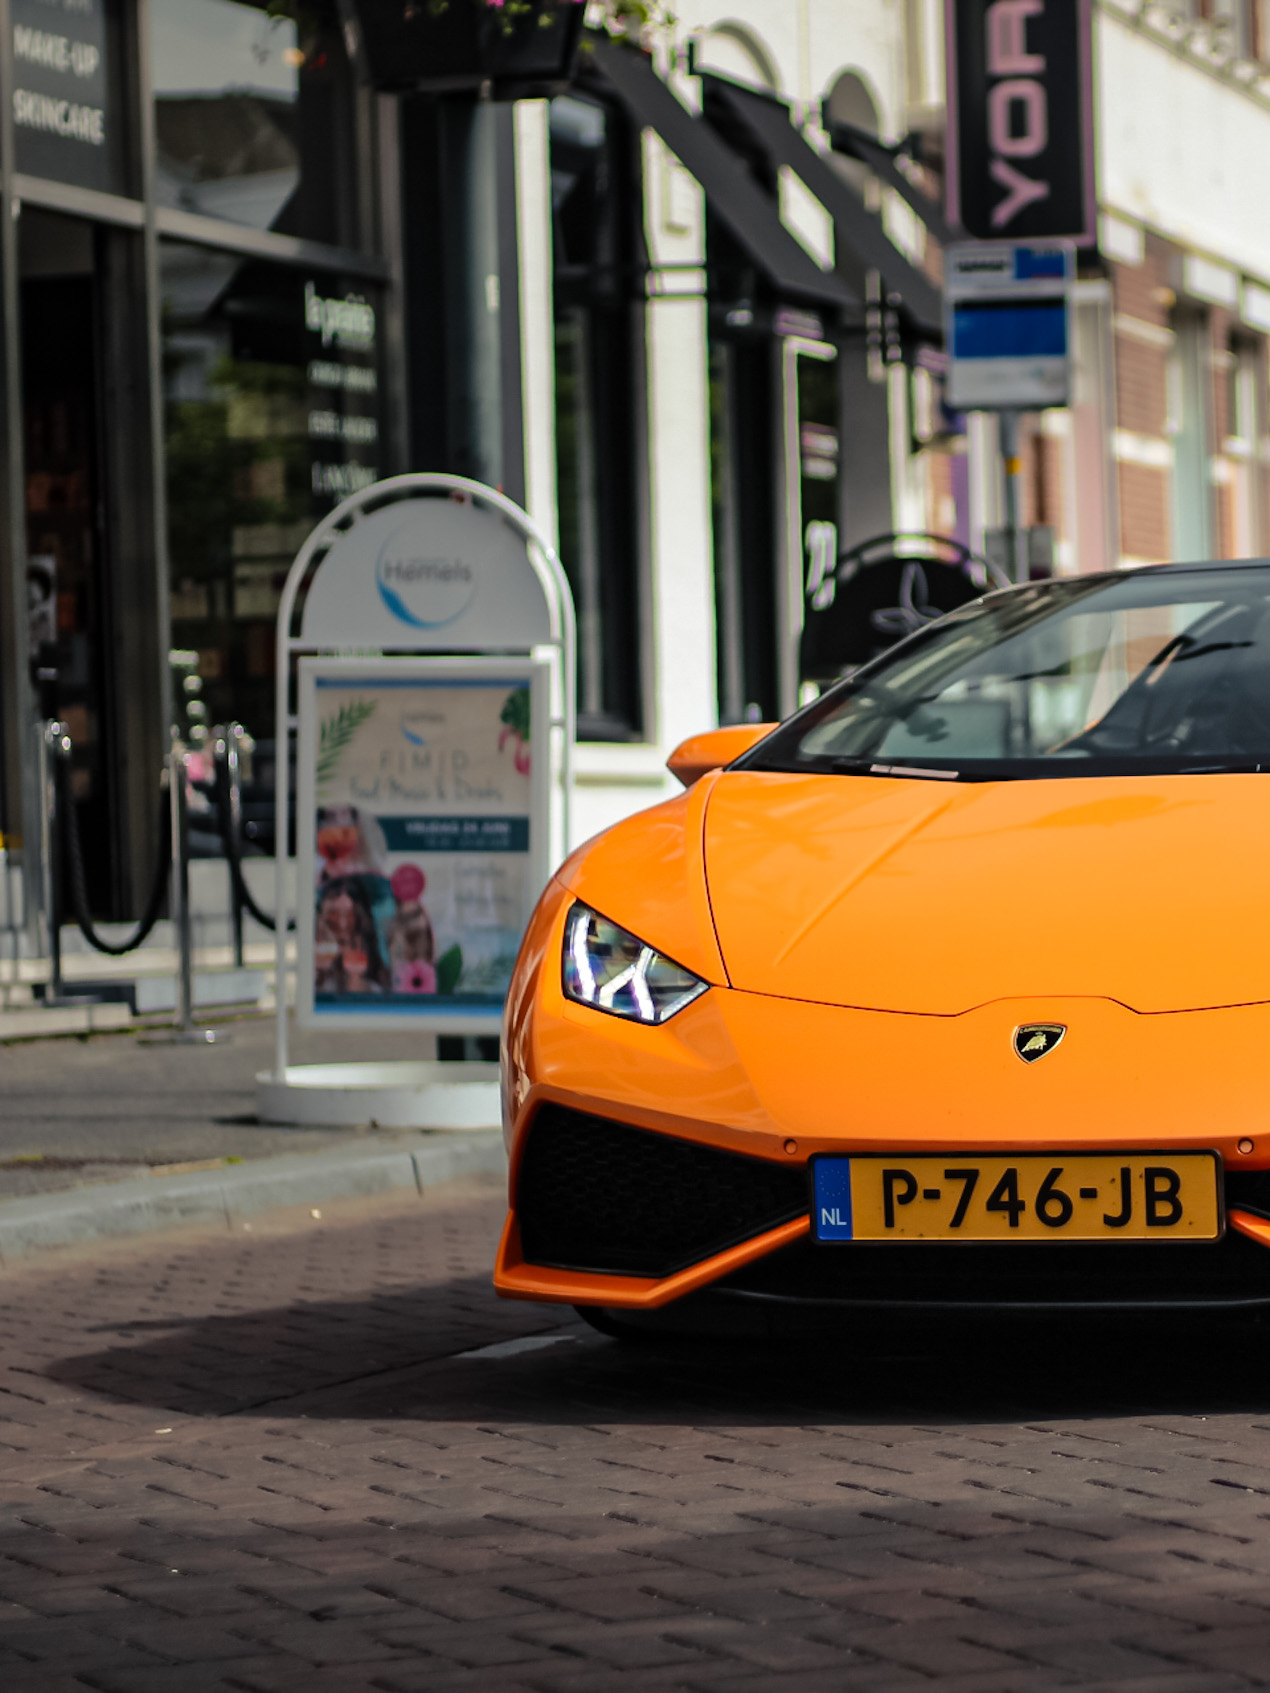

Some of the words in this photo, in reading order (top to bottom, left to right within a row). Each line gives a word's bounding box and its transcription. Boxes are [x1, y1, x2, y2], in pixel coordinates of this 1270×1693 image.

[14, 23, 99, 78] MAKE-UP
[13, 88, 104, 146] SKINCARE
[821, 1208, 847, 1226] NL
[882, 1166, 1183, 1228] P-746-JB
